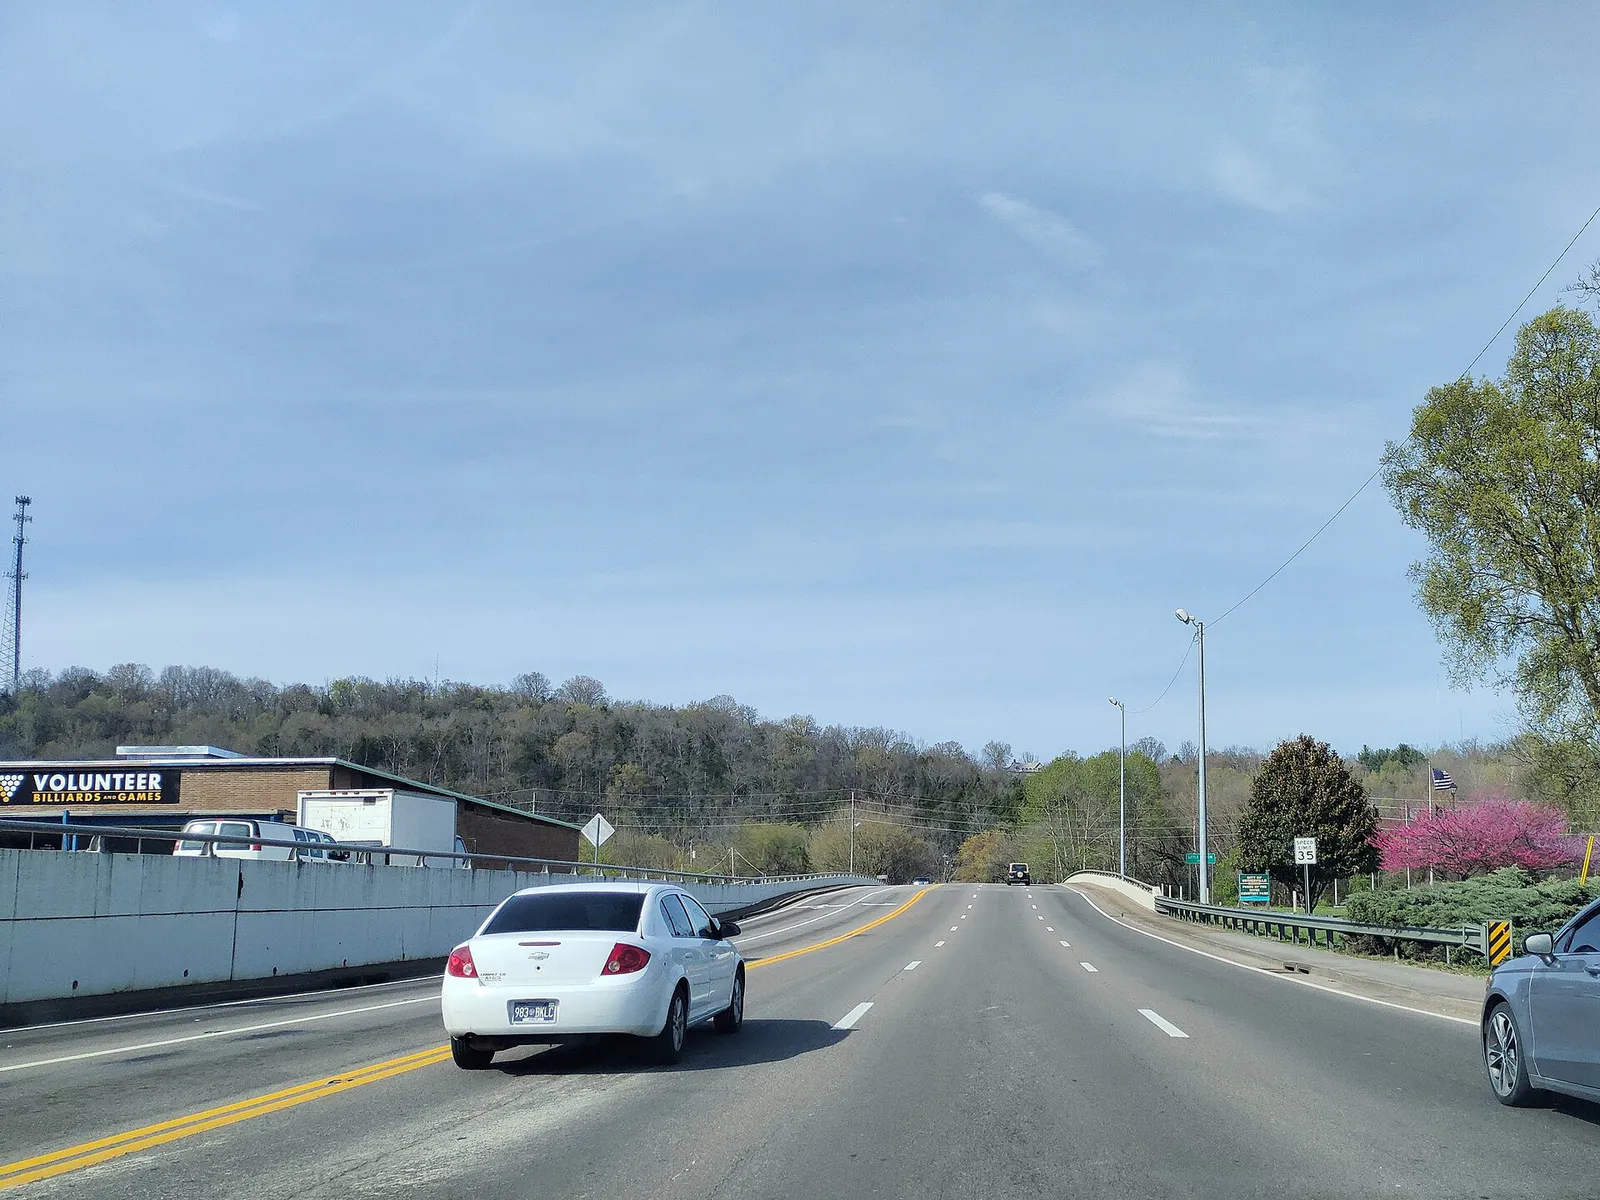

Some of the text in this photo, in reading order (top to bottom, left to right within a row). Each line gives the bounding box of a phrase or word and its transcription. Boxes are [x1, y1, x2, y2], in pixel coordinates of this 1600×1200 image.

[32, 773, 162, 791] VOLUNTEER
[33, 792, 101, 803] BILLIARDS
[118, 791, 162, 802] GAMES
[1297, 850, 1314, 861] 35
[514, 1007, 554, 1018] 983 BKLC
